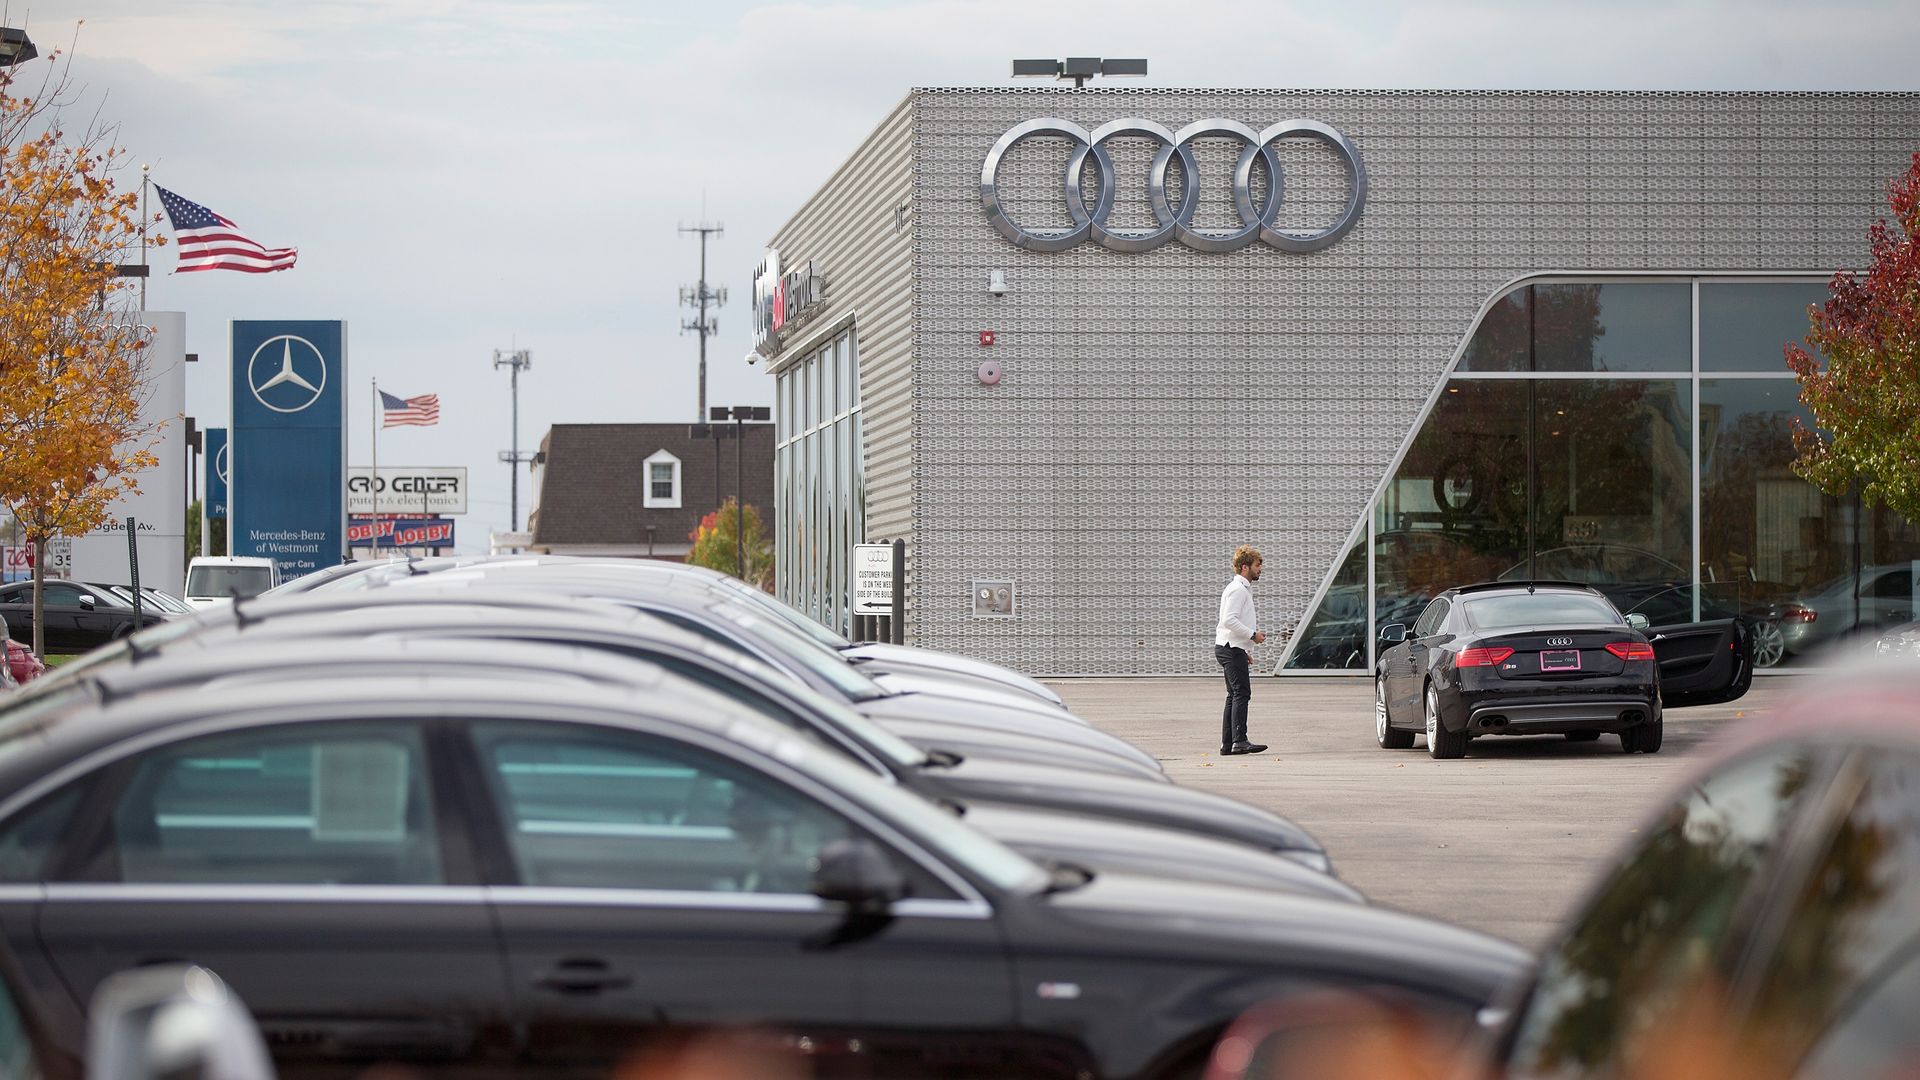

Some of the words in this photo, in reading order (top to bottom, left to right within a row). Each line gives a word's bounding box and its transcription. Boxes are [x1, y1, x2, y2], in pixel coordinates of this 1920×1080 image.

[349, 477, 386, 493] CRO
[392, 477, 459, 493] CENTER
[397, 495, 459, 505] electonics
[94, 522, 128, 533] Ogde
[137, 522, 156, 531] Av.
[250, 530, 326, 541] Mercedes-Benz
[347, 521, 395, 541] OBBY
[394, 523, 453, 546] LOBBY
[26, 542, 35, 557] ST
[256, 542, 266, 553] of
[269, 543, 319, 553] Westmont
[297, 560, 316, 568] Cars
[859, 570, 880, 578] CUSTOMER
[881, 570, 892, 578] PARK
[863, 580, 867, 588] IS
[868, 580, 874, 588] ON
[874, 580, 882, 588] THE
[857, 590, 866, 598] SIDE
[867, 590, 872, 598] OF
[881, 590, 893, 598] BUILD
